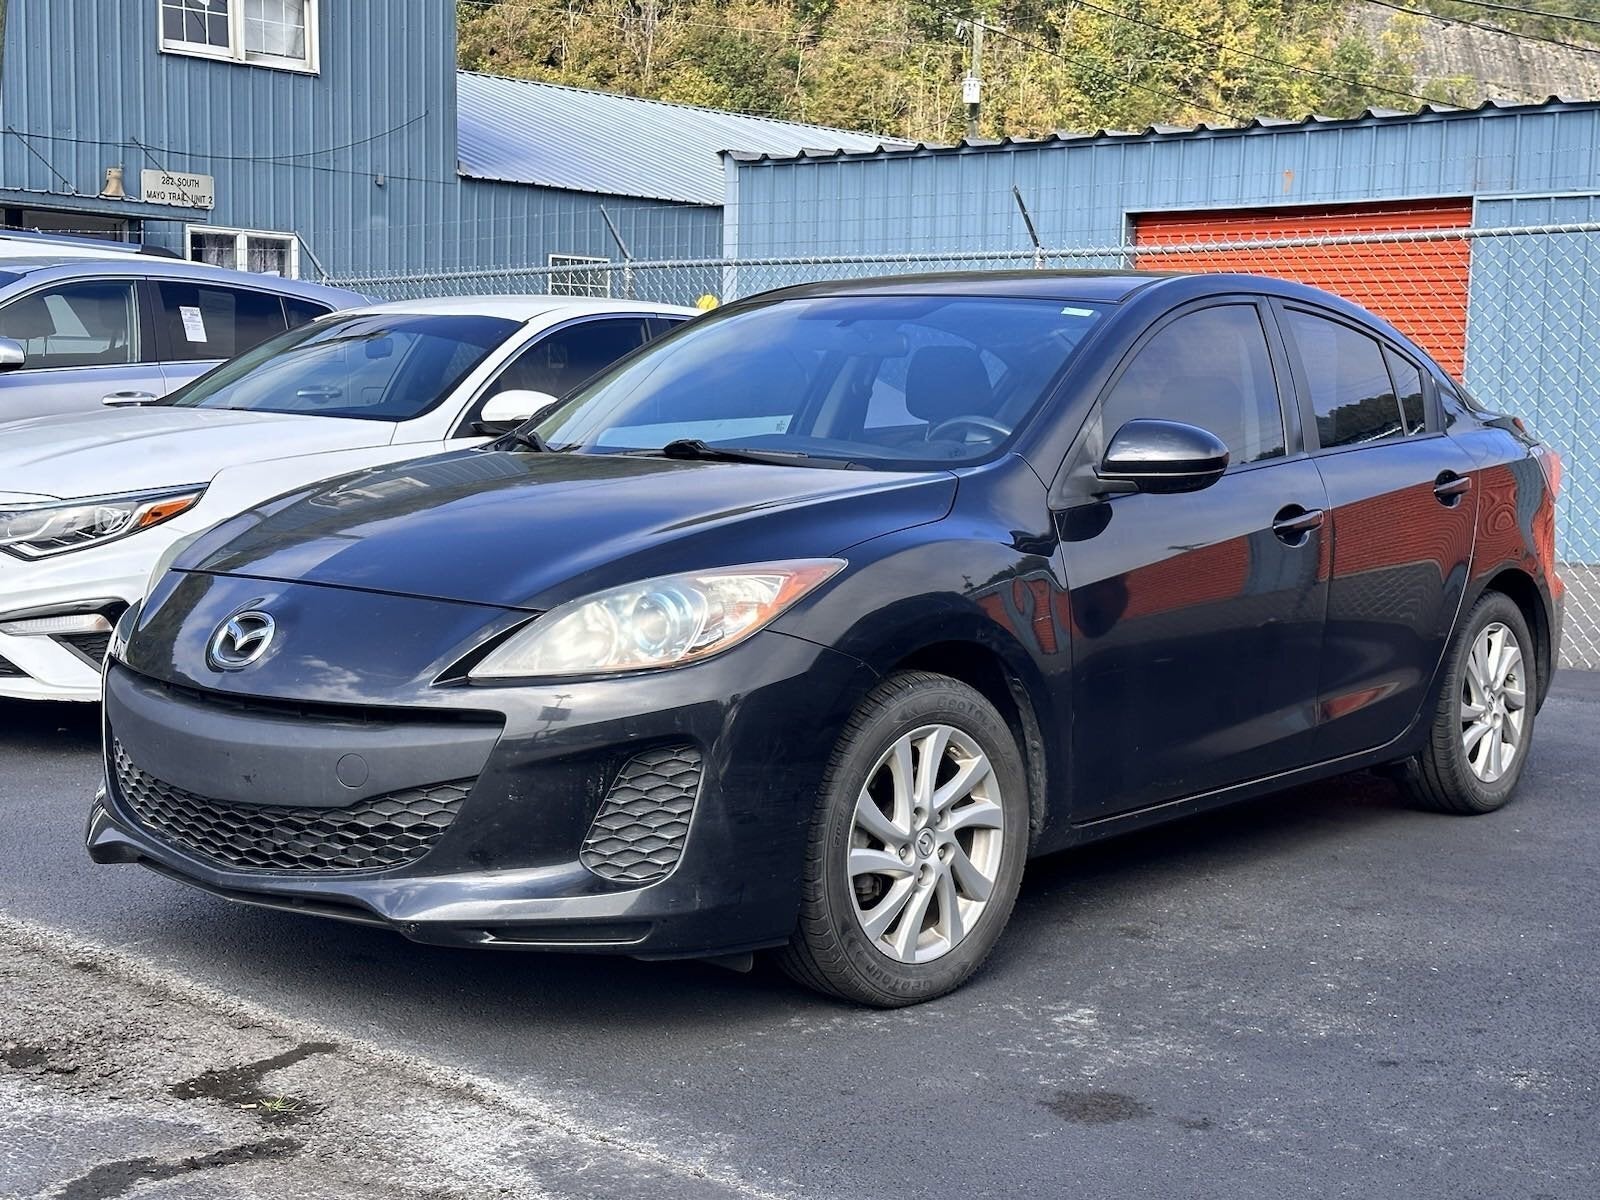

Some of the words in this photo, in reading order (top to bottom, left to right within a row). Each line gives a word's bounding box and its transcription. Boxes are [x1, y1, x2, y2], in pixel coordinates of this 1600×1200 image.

[177, 177, 200, 188] SOUTH
[146, 190, 165, 200] MAYO
[191, 194, 206, 204] UNIT
[208, 196, 213, 204] 2
